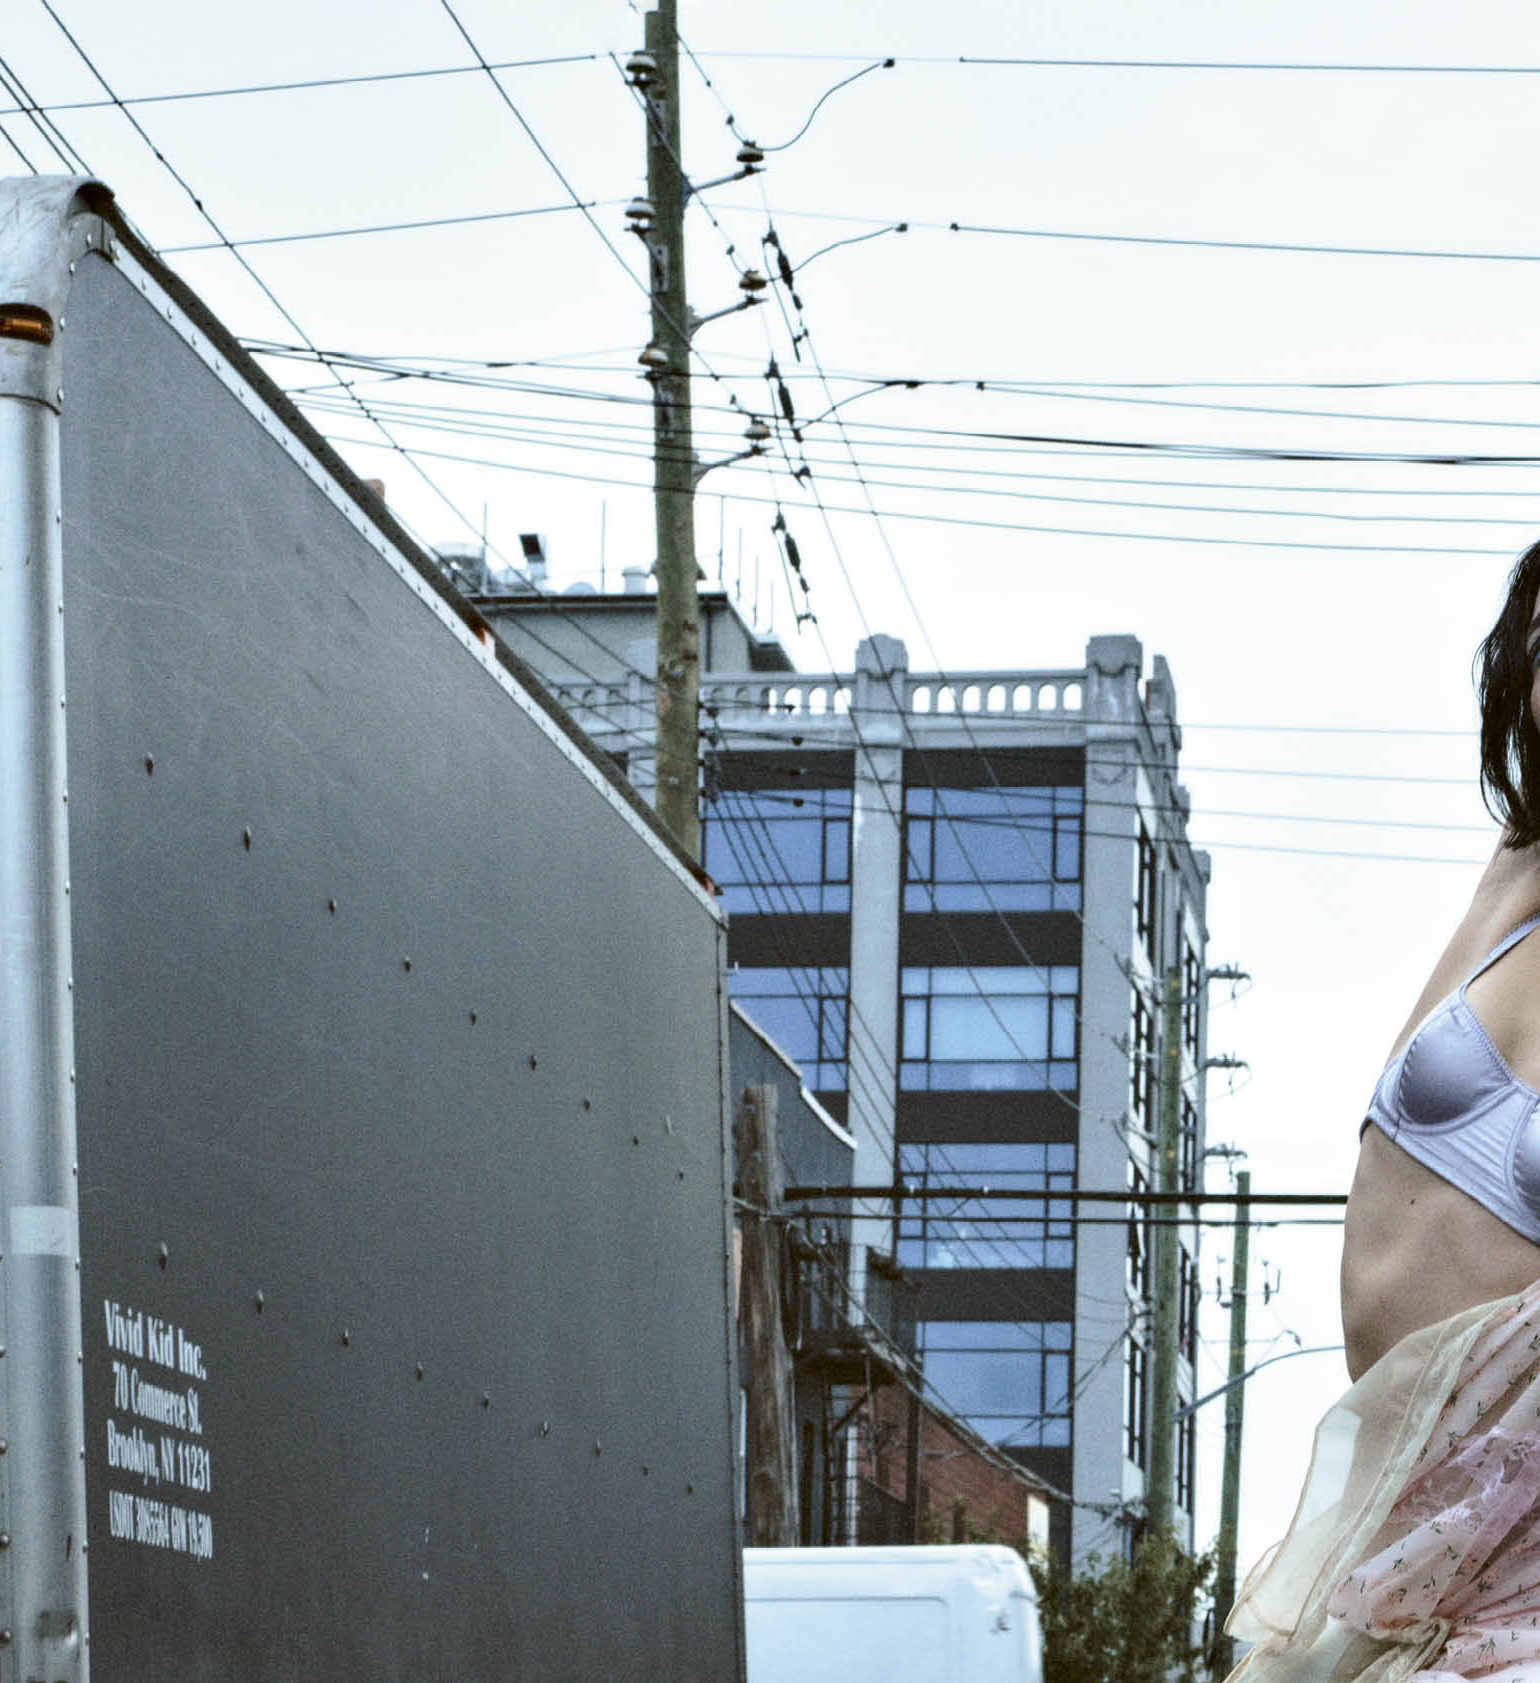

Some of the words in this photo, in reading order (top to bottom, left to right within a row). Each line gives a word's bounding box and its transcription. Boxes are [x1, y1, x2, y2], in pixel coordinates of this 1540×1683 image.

[104, 1299, 143, 1358] Vivid
[148, 1315, 174, 1368] Kid
[178, 1327, 207, 1380] Inc.
[113, 1360, 128, 1411] 70
[131, 1367, 186, 1431] Commerce
[188, 1387, 202, 1434] St.
[107, 1418, 159, 1486] Brooklyn,
[161, 1434, 175, 1482] NY
[177, 1440, 211, 1493] 11231
[109, 1489, 135, 1541] USDOT
